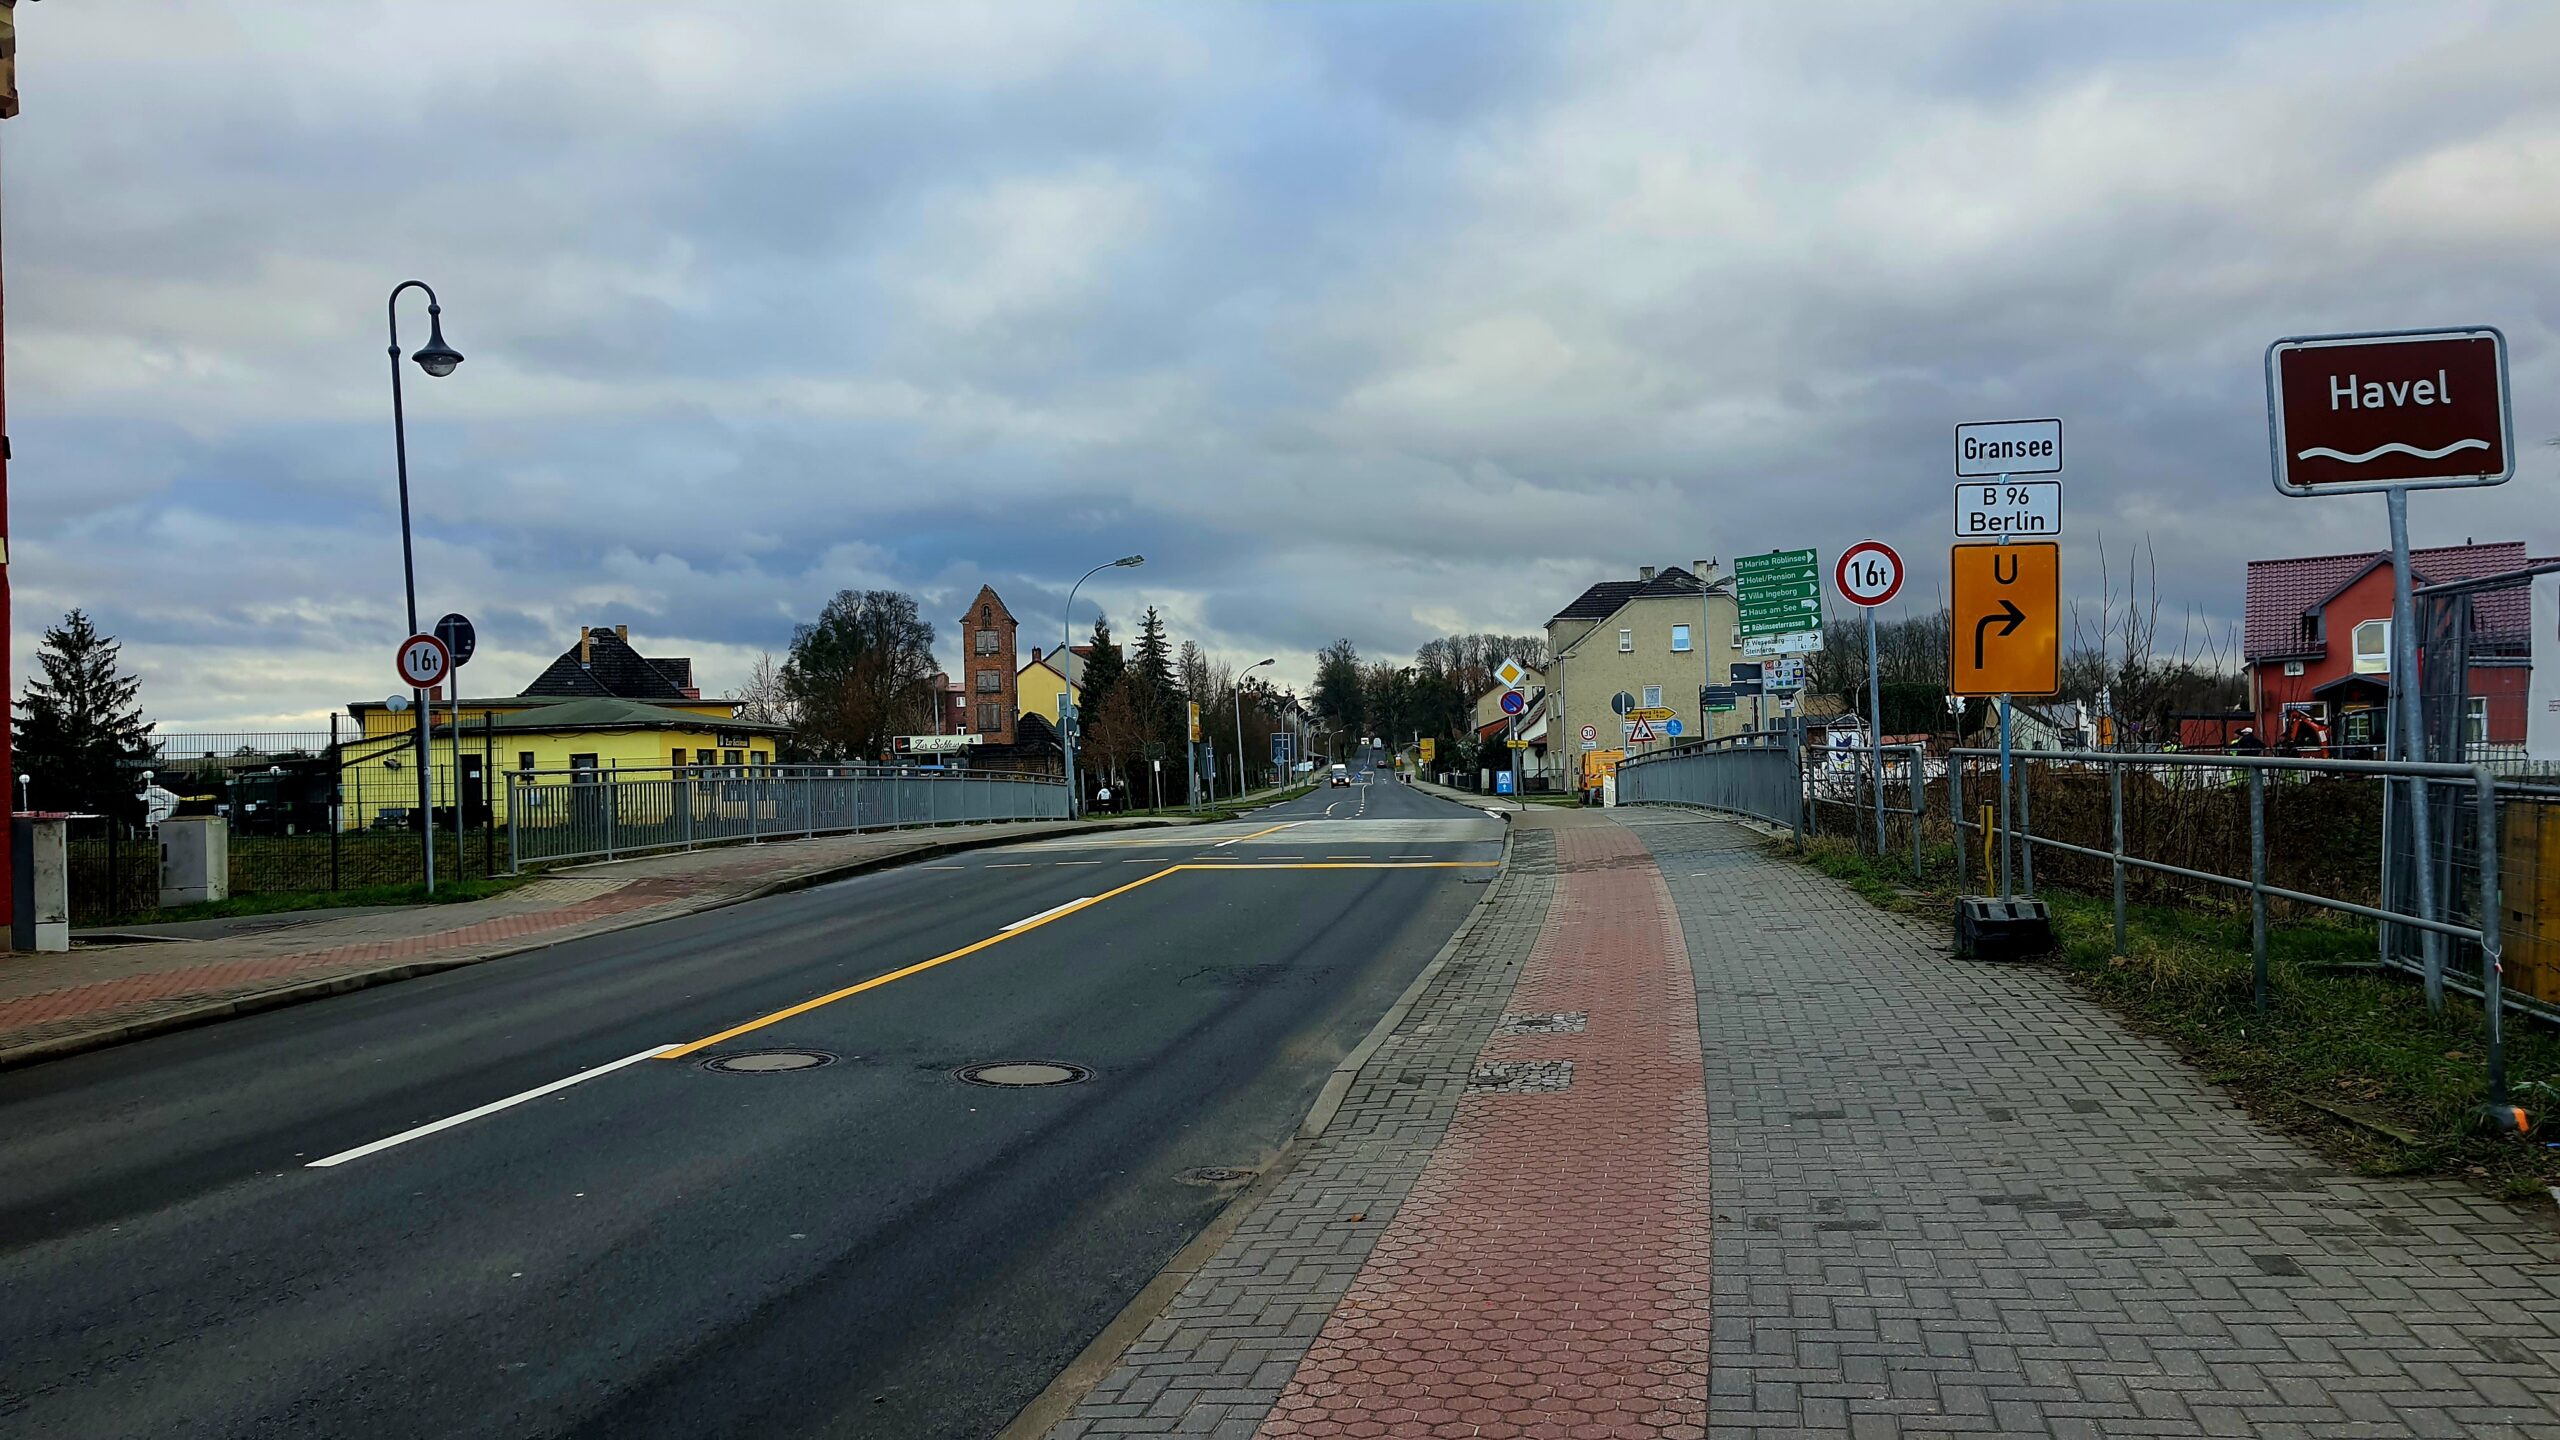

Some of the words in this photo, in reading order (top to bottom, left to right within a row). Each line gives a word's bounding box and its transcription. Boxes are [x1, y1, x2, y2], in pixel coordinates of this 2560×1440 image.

[2329, 369, 2451, 410] Havel
[1964, 437, 2053, 460] Gransee
[1983, 487, 1997, 506] B
[2006, 486, 2029, 506] 96
[1970, 510, 2045, 532] Berlin
[1744, 559, 1770, 568] Marina
[1771, 554, 1807, 565] Röblinsee
[1994, 553, 2018, 585] U
[1746, 572, 1796, 585] Hotel/Pension
[1850, 559, 1887, 588] 16t
[1747, 592, 1764, 600] Villa
[1765, 588, 1798, 599] Ingeborg
[1748, 607, 1768, 616] Haus
[1783, 604, 1797, 612] See
[410, 649, 438, 671] 16t
[1584, 729, 1594, 737] 30
[914, 739, 928, 750] Zur
[929, 738, 961, 751] Schleus
